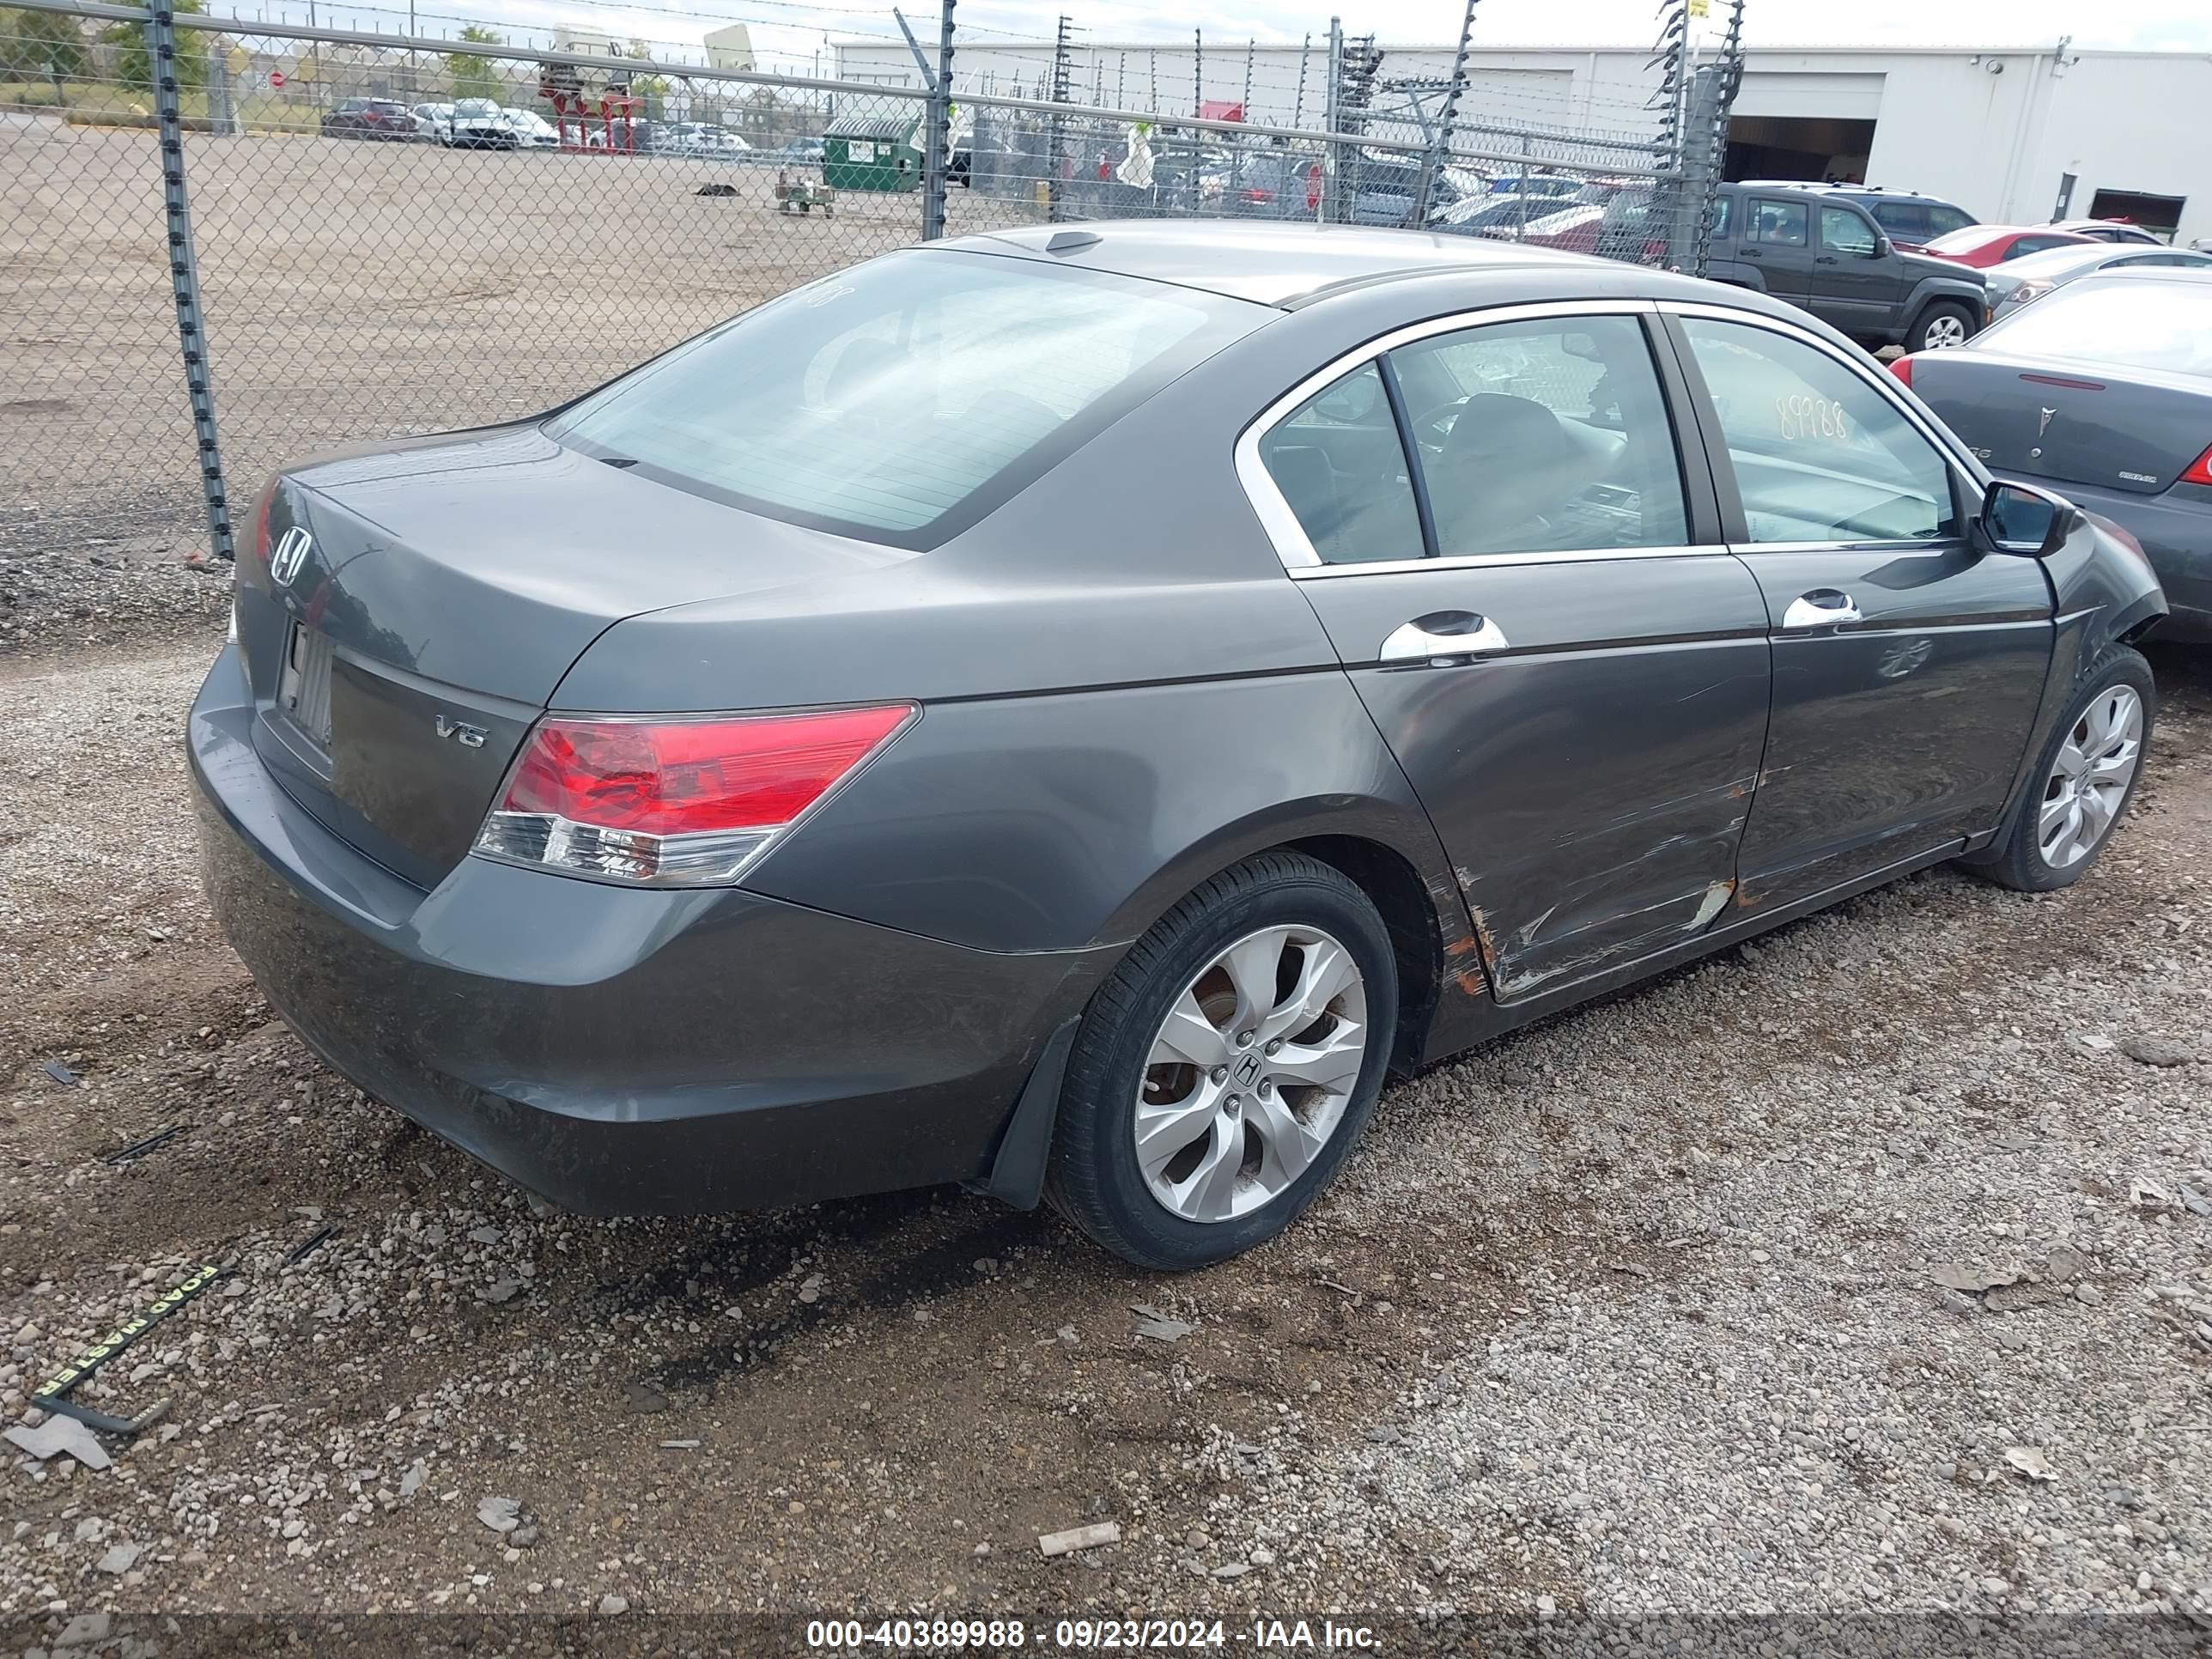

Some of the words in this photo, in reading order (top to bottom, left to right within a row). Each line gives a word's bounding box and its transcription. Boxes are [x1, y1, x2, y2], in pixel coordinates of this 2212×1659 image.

[1776, 394, 1846, 440] 89988
[435, 714, 489, 748] V6
[149, 1265, 219, 1314] ROAD
[34, 1318, 148, 1396] MASTER
